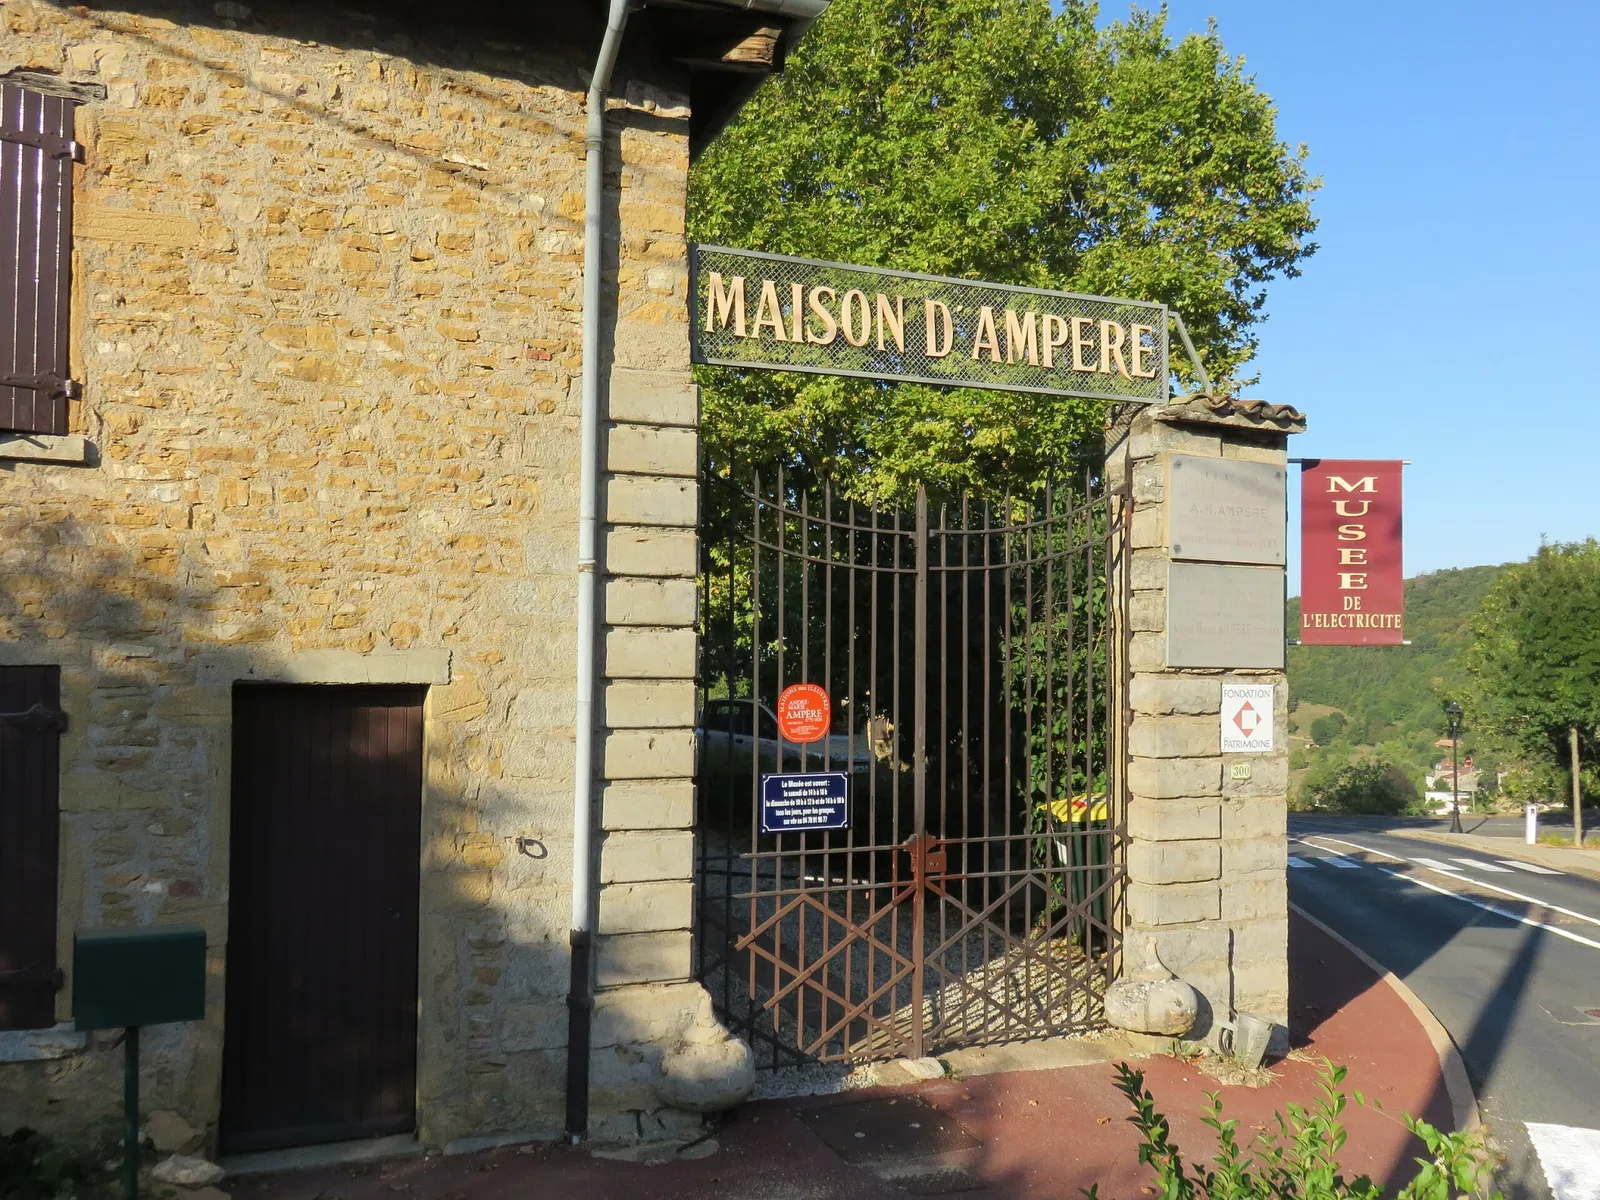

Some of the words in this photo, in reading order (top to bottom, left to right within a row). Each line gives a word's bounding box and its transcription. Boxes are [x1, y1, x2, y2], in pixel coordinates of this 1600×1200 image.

[704, 271, 904, 354] MAISON
[1326, 476, 1378, 590] MUSEE
[1344, 596, 1362, 611] DE
[1304, 613, 1402, 628] L'ELECTRICITE
[1224, 688, 1270, 698] FONDATION
[786, 708, 822, 719] AMPÈRE
[1224, 739, 1270, 749] PATRIMOINE
[1233, 766, 1250, 777] 300
[771, 799, 789, 807] dimanche
